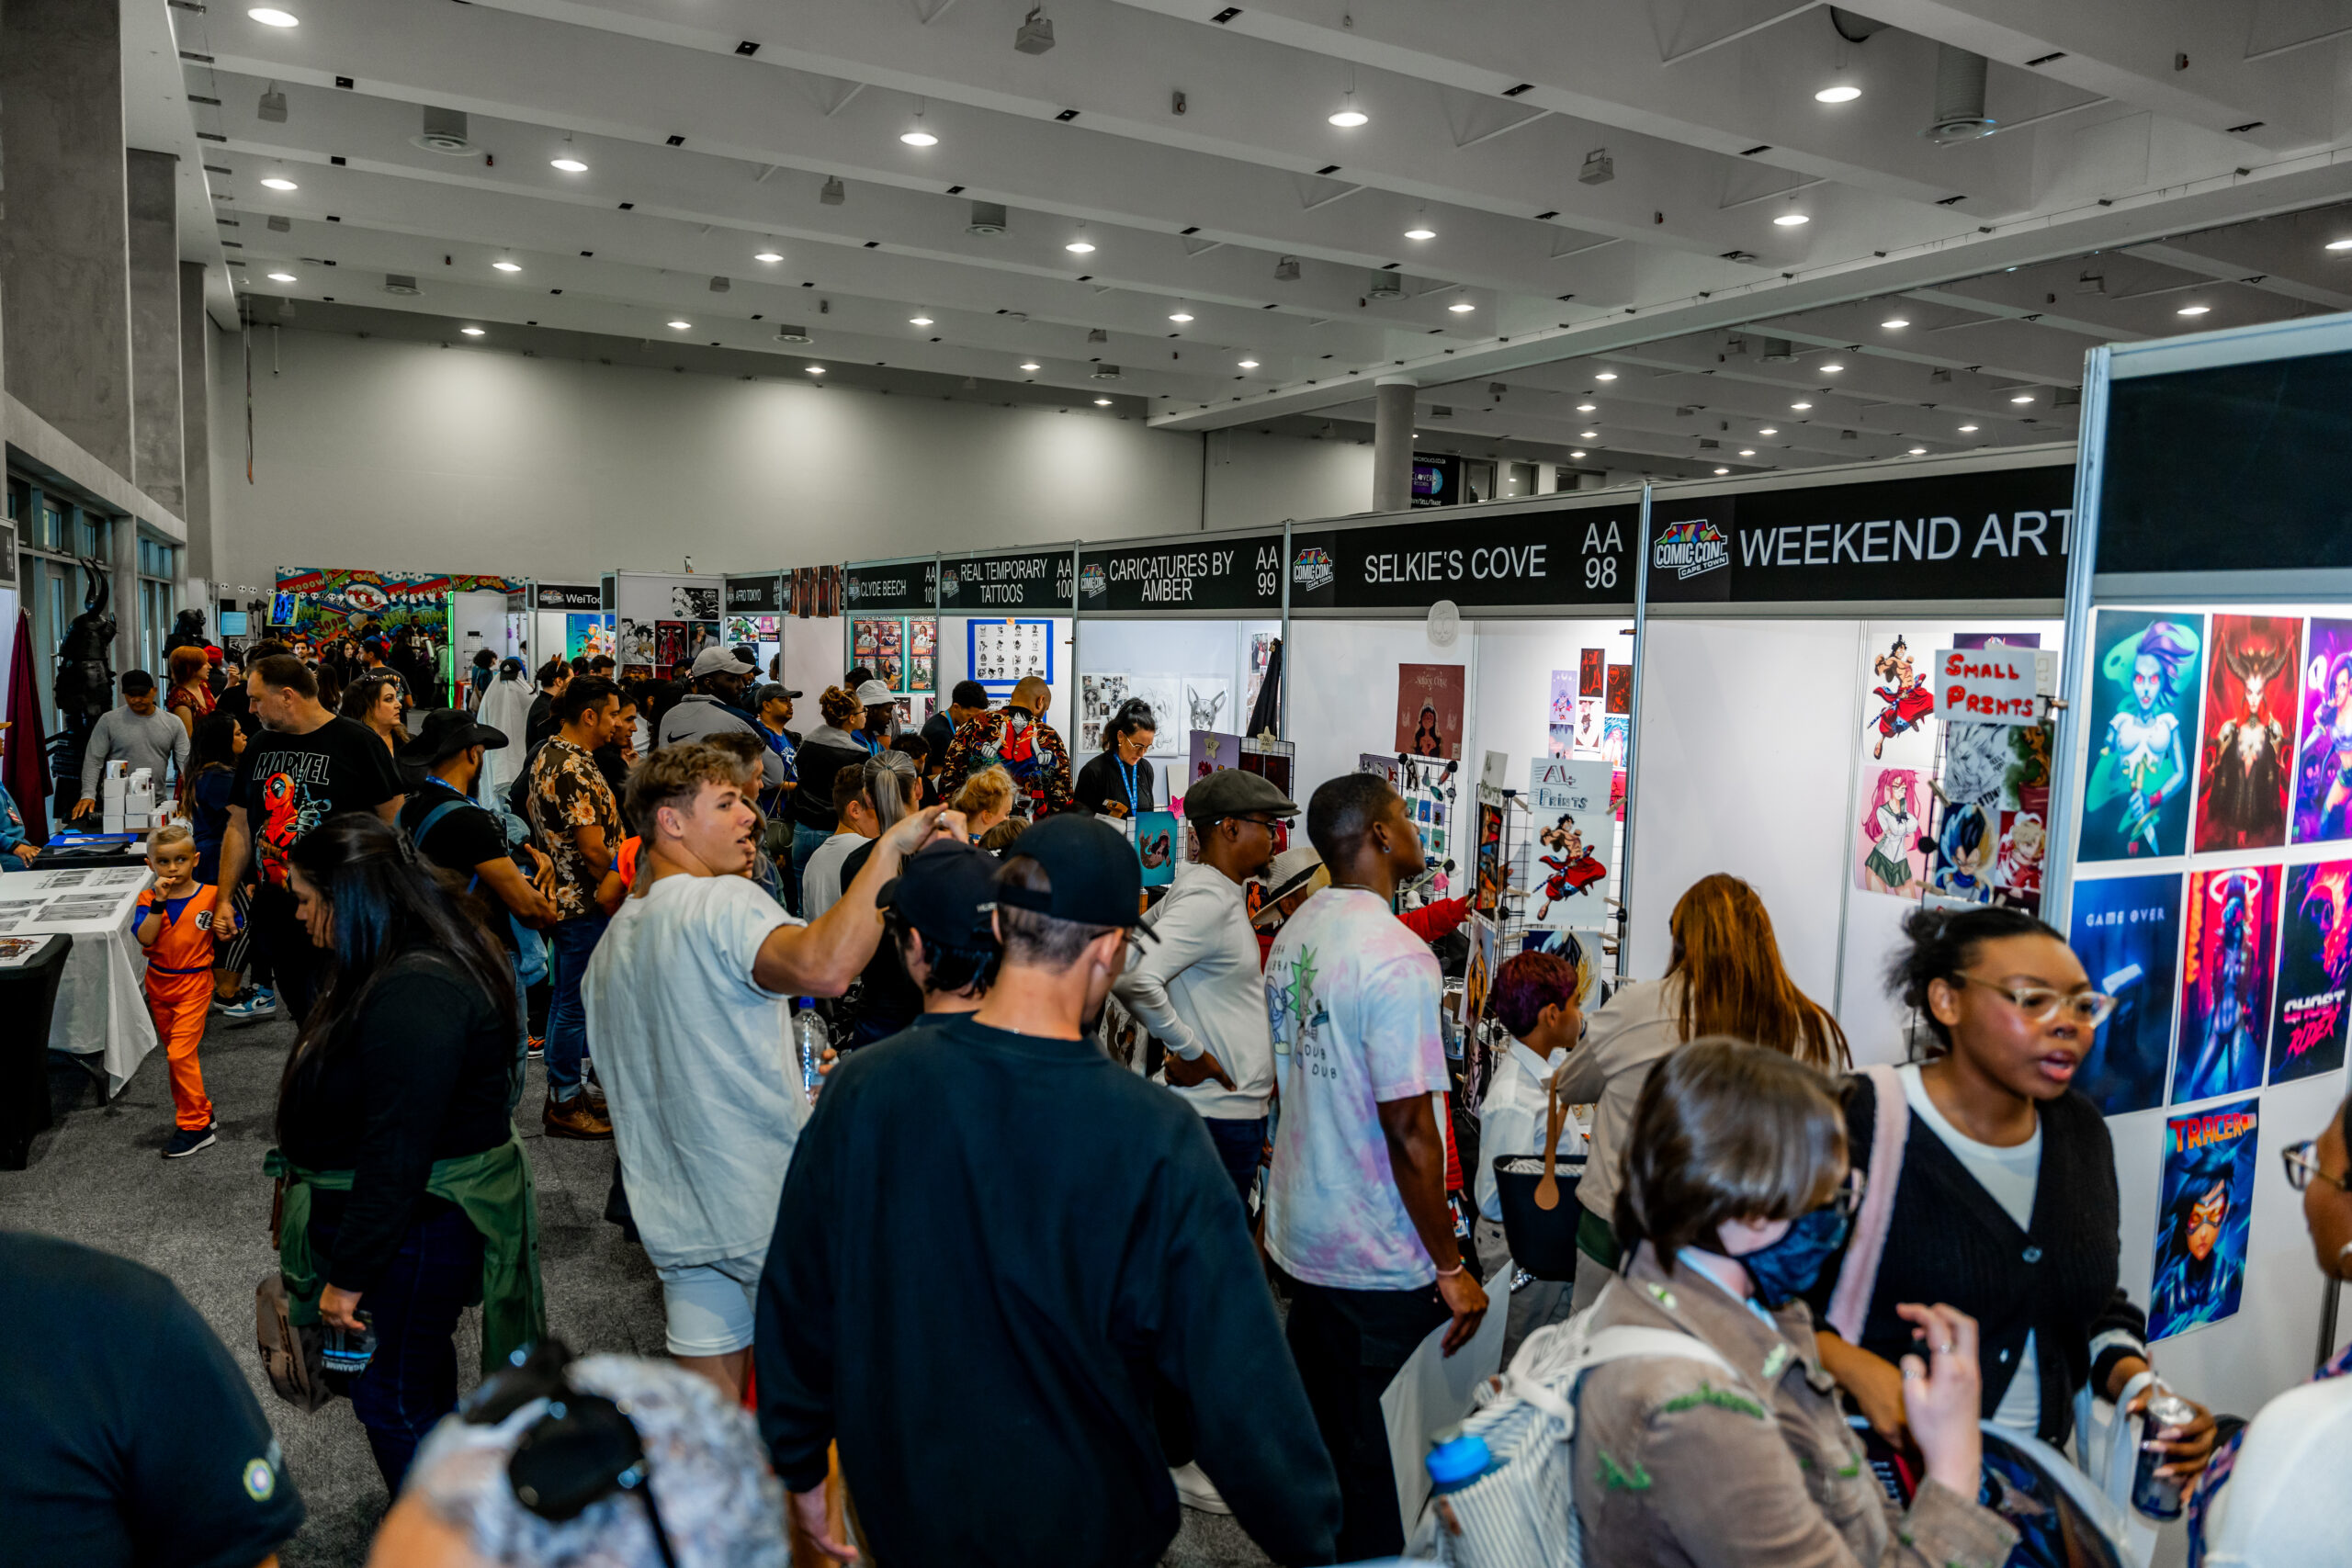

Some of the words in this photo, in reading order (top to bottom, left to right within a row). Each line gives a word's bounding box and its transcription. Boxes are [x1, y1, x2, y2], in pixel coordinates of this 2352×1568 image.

[1581, 521, 1623, 555] AA
[1739, 516, 1962, 567] WEEKEND
[1972, 509, 2074, 558] ART
[1255, 546, 1279, 570] AA
[1364, 549, 1464, 583] SELKIE'S
[1471, 545, 1547, 579] COVE
[1656, 540, 1721, 565] COMIC-CON
[924, 566, 935, 582] AA
[960, 563, 984, 581] REAL
[985, 558, 1047, 581] TEMPORARY
[1057, 558, 1072, 578] AA
[1109, 553, 1207, 581] CARICATURES
[1213, 550, 1234, 576] BY
[1585, 557, 1618, 589] 98
[1681, 564, 1702, 576] CAPE
[1702, 557, 1725, 569] TOWN
[860, 581, 882, 597] CLYDE
[883, 580, 907, 596] BEECH
[924, 586, 936, 603] 101
[980, 583, 1023, 604] TATTOOS
[1057, 580, 1073, 598] 100
[1141, 577, 1193, 602] AMBER
[1258, 572, 1276, 596] 99
[1945, 653, 2019, 680] SMALL
[1946, 685, 2033, 716] PRINTS
[253, 751, 330, 785] MARVEL
[2086, 910, 2125, 928] GAME
[2129, 907, 2165, 923] OVER
[2283, 989, 2346, 1024] GHOST
[2287, 1011, 2338, 1058] RIDER
[1312, 1063, 1337, 1080] DUB
[2169, 1111, 2243, 1153] TRACER
